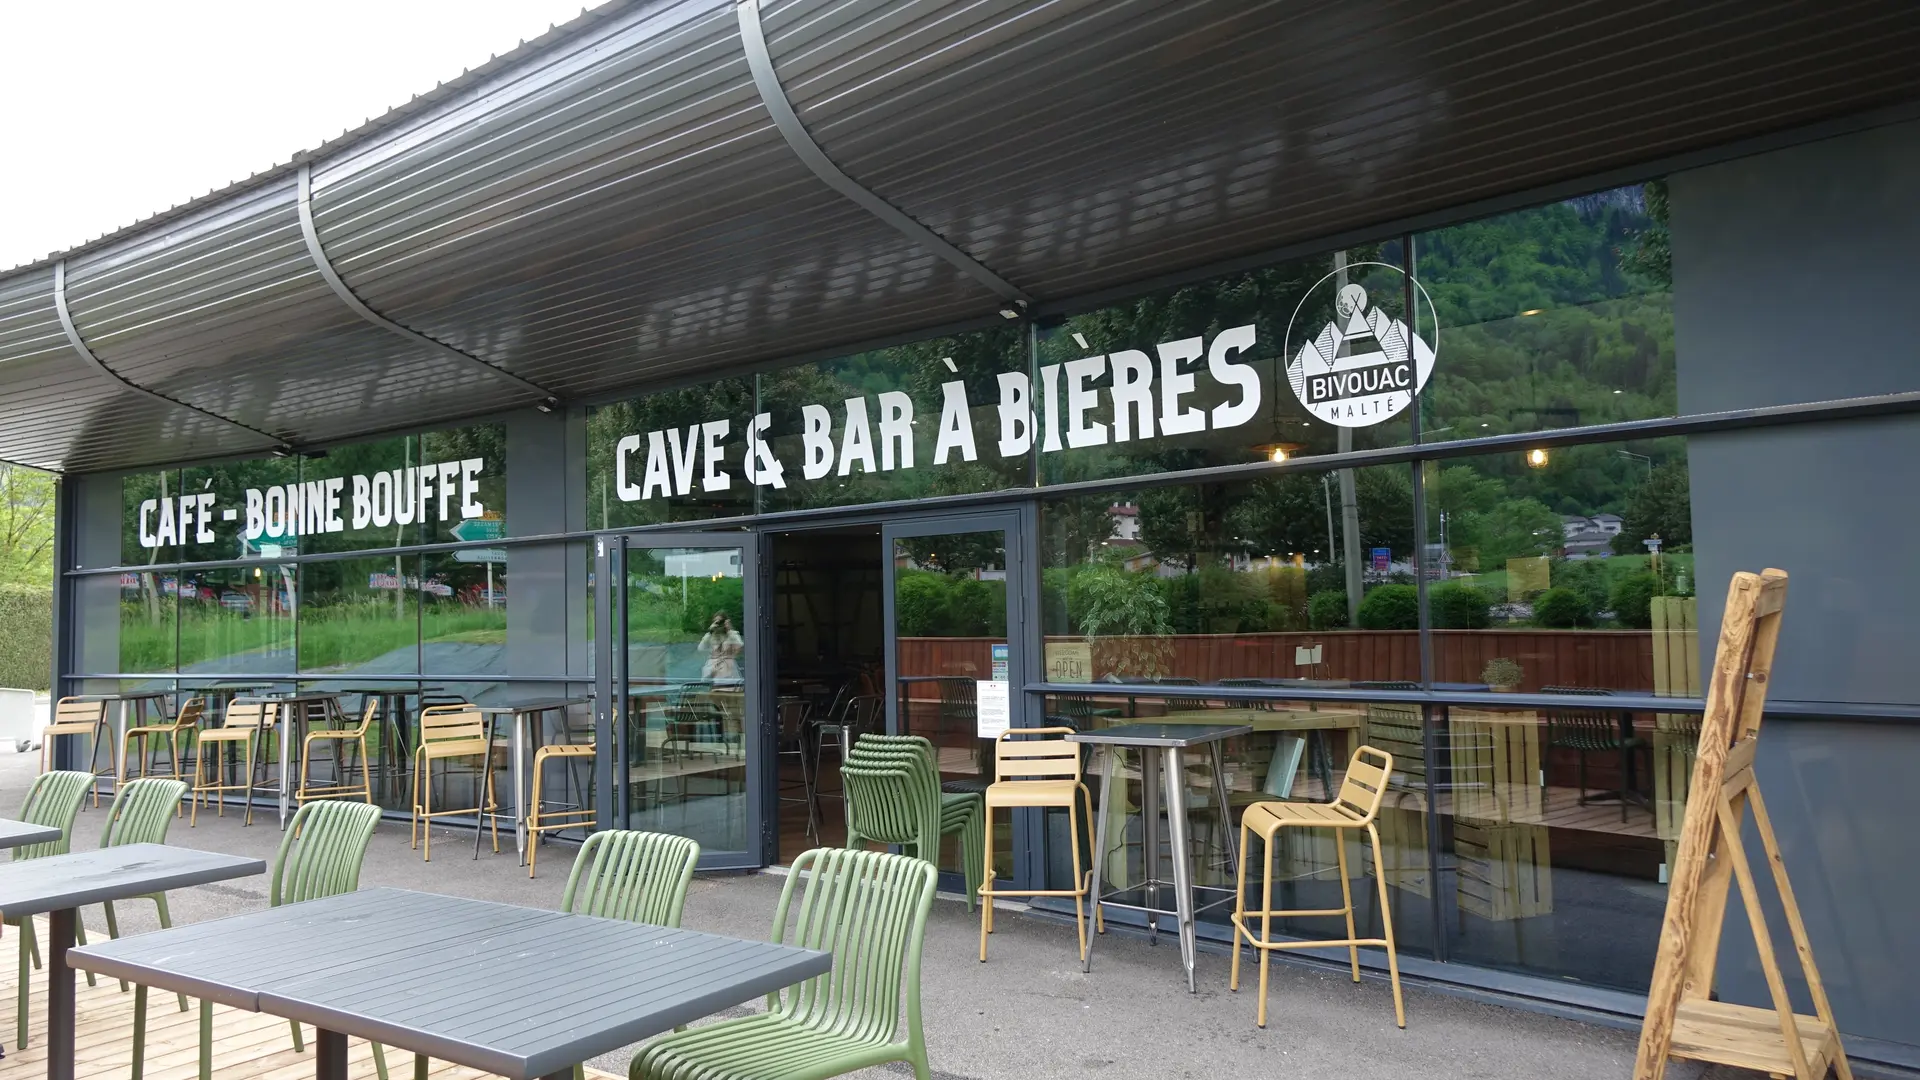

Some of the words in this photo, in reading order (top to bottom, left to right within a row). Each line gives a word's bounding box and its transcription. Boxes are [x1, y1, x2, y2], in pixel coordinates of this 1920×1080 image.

[1312, 364, 1410, 400] BIVOUAC
[616, 419, 731, 502] CAVE
[744, 412, 787, 489] &
[801, 390, 918, 481] BAR
[933, 357, 978, 465] À
[996, 325, 1261, 458] BIÈRES
[1331, 396, 1394, 420] MALTÉ
[139, 478, 216, 548] CAFÉ
[245, 476, 344, 540] BONNE
[352, 457, 484, 530] BOUFFE
[1056, 660, 1083, 679] OPEN
